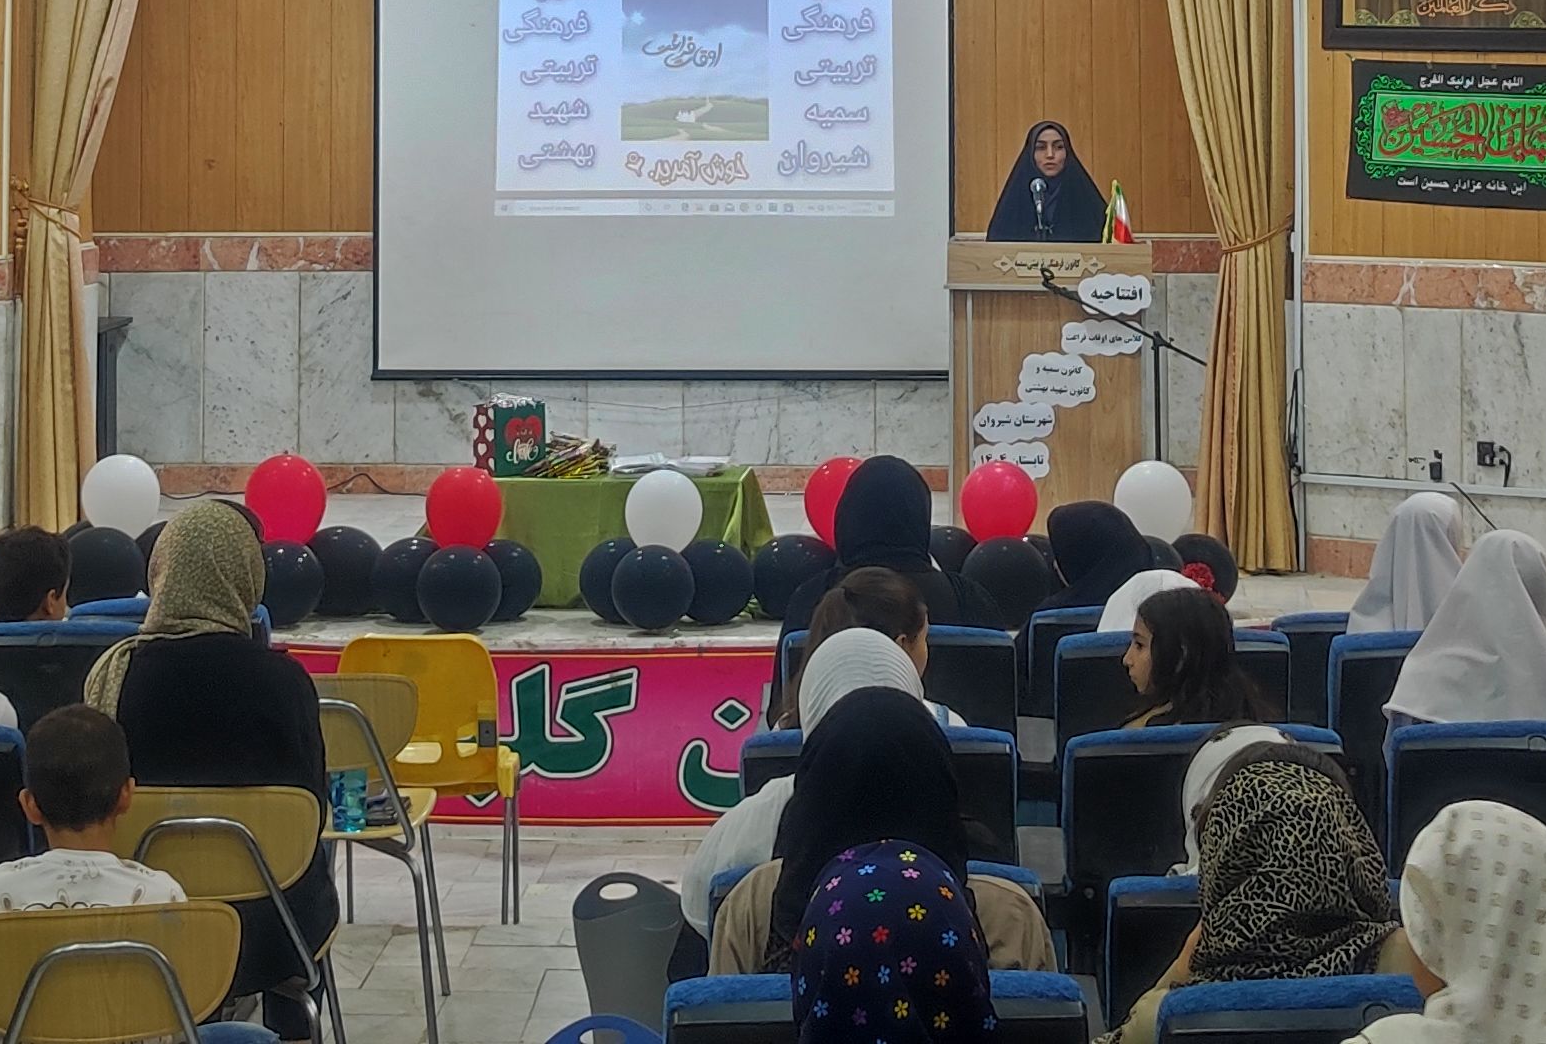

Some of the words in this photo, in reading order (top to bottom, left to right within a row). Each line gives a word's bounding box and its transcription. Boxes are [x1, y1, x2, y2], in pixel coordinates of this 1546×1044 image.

[503, 7, 589, 43] فرهنگی
[781, 3, 875, 42] فرهنگی
[642, 33, 696, 59] فراغت
[664, 42, 722, 68] اوقات
[520, 54, 599, 85] تربیتی
[794, 54, 876, 86] تربیتی
[1420, 74, 1444, 88] الفرج
[1447, 75, 1474, 89] لولیک
[1478, 76, 1498, 89] عجل
[1502, 76, 1523, 90] اللهم
[528, 98, 590, 125] شهید
[804, 103, 869, 129] سمیه
[518, 140, 596, 170] بهشتی
[777, 140, 870, 175] شیروان
[700, 151, 749, 185] خوش
[1397, 175, 1419, 187] است
[1421, 177, 1450, 191] حسین
[1453, 179, 1482, 193] عزادار
[1486, 179, 1508, 192] خانه
[1510, 181, 1527, 196] این
[1065, 258, 1081, 271] کانون
[1090, 285, 1143, 304] افتتاحیه
[1065, 332, 1087, 343] فراغت
[1088, 333, 1108, 344] اوقات
[1108, 334, 1123, 344] های
[1123, 334, 1142, 344] کلاس
[1035, 366, 1041, 374] و
[1060, 365, 1083, 376] کانون
[1025, 383, 1049, 394] بهشتی
[1050, 384, 1068, 395] شهید
[1069, 386, 1092, 397] کانون
[978, 414, 1012, 428] شیروان
[1013, 414, 1053, 428] شهرستان
